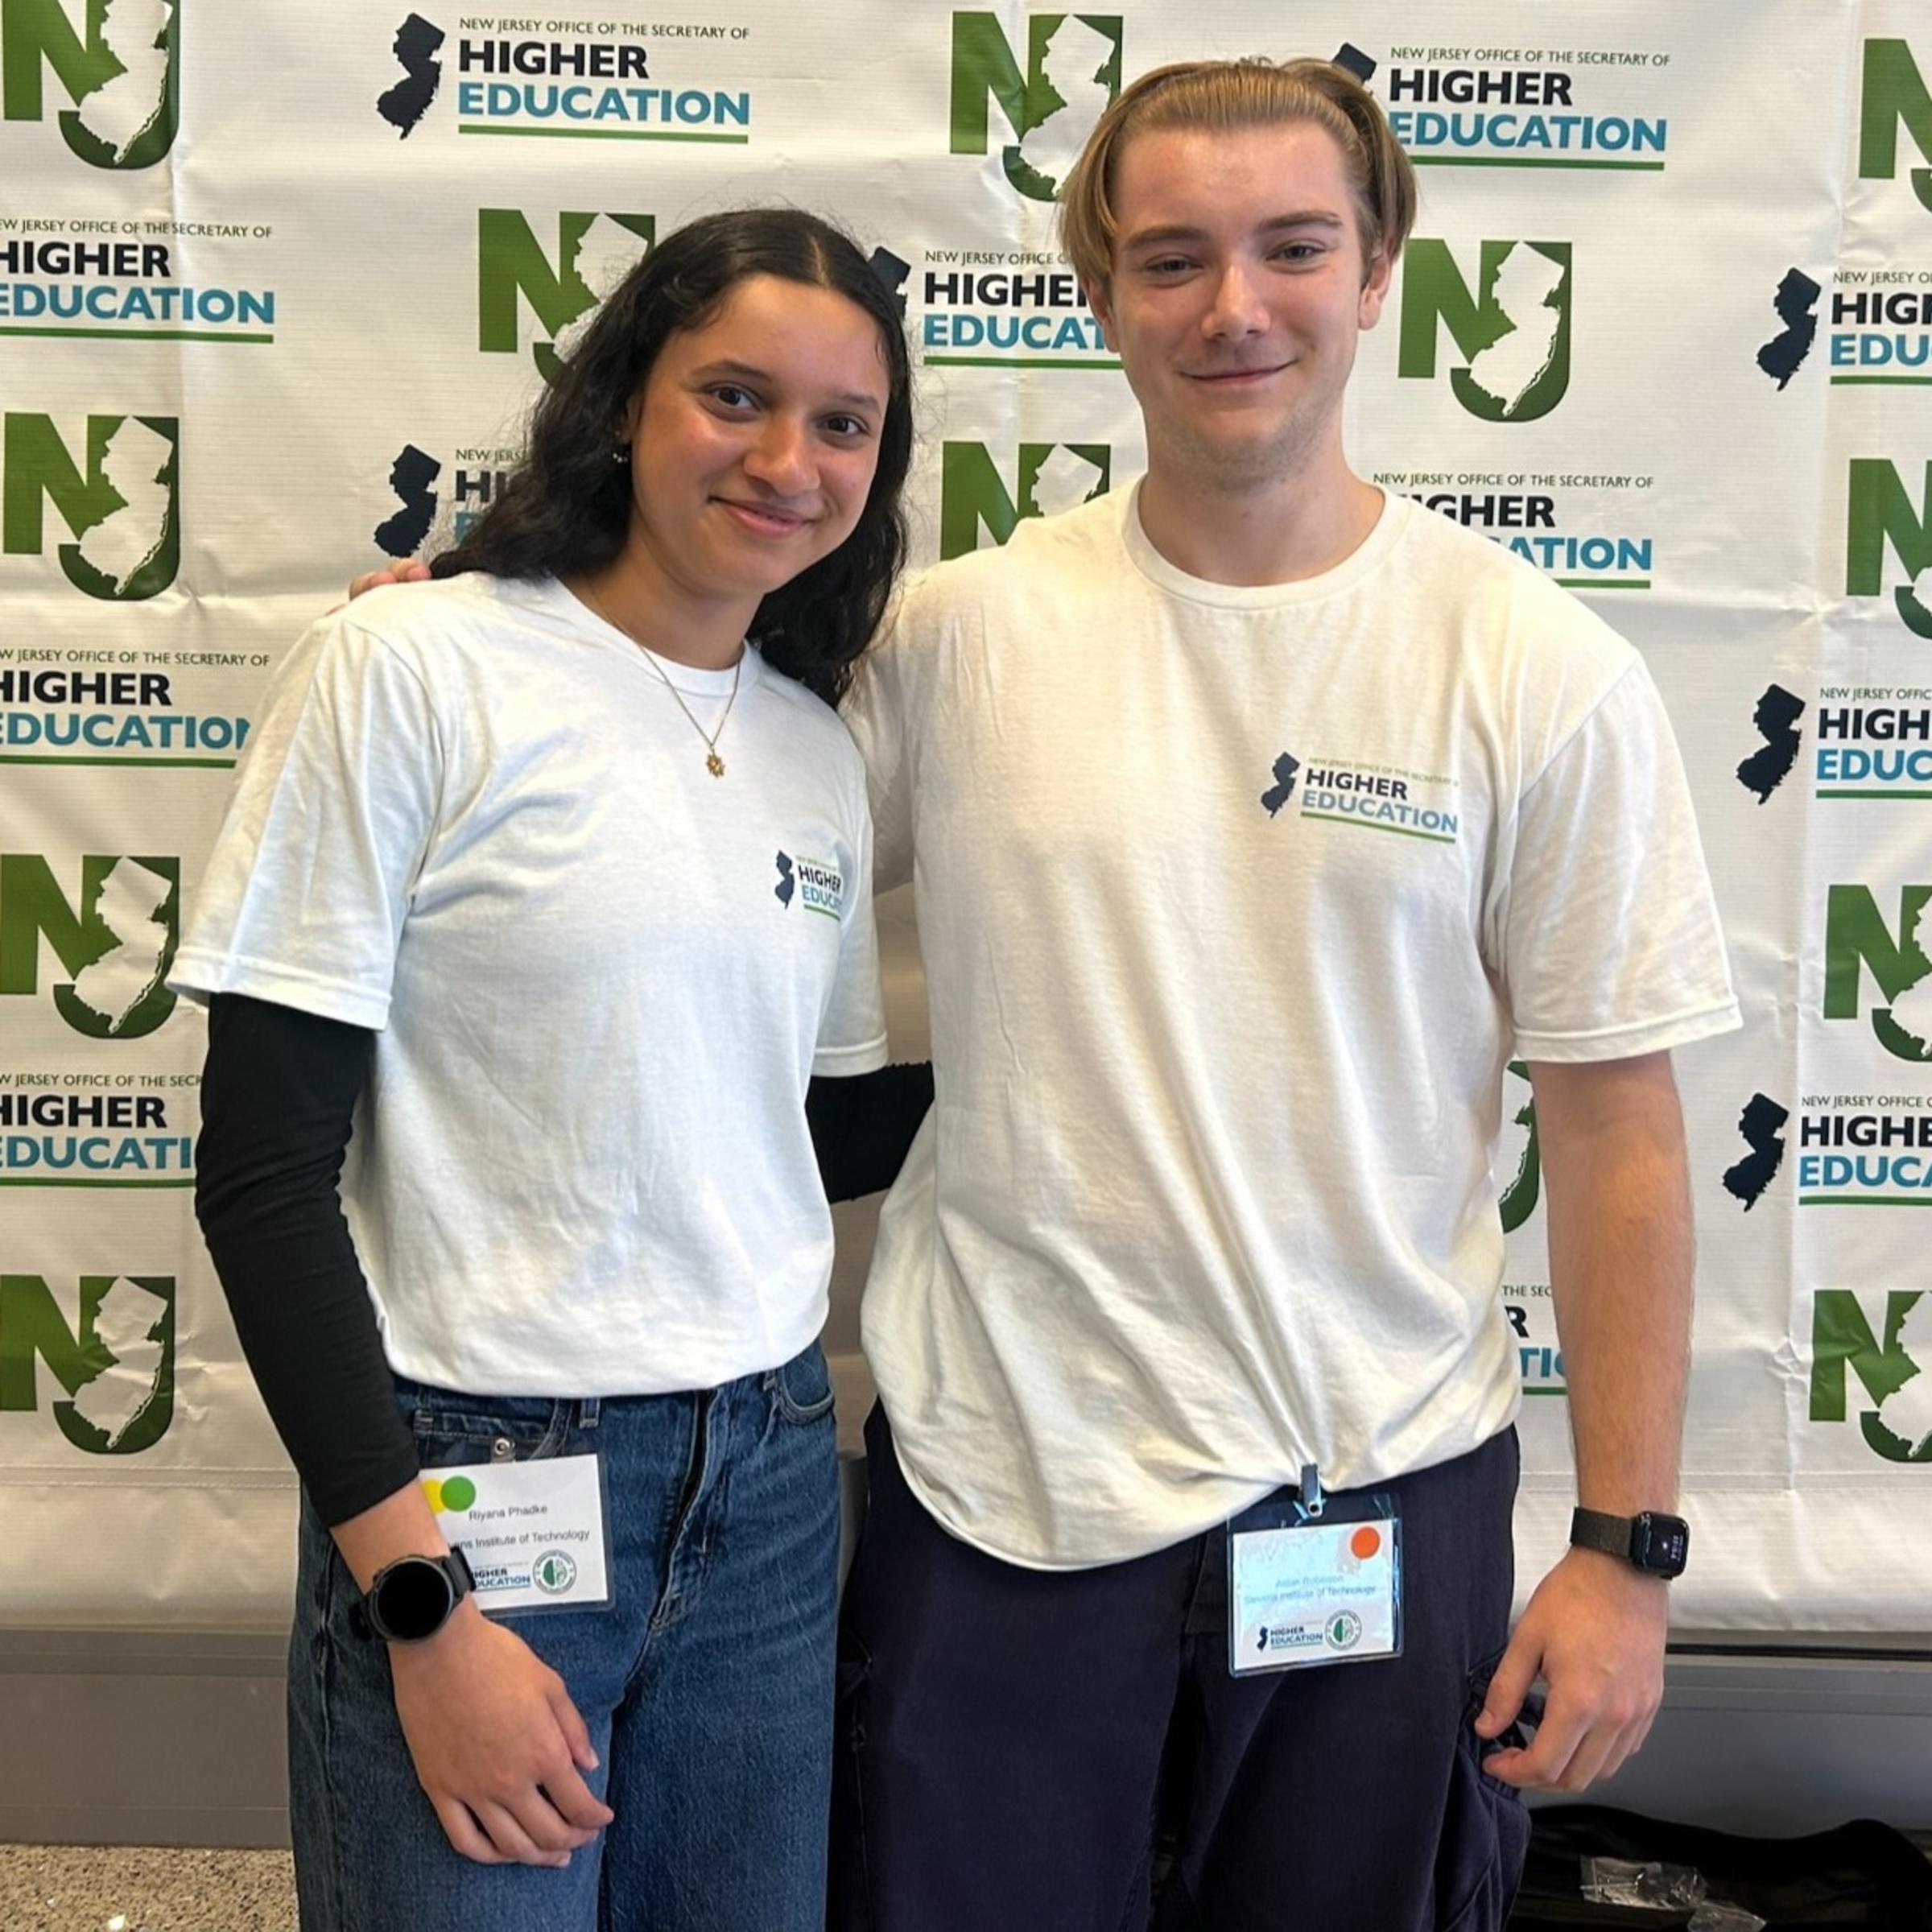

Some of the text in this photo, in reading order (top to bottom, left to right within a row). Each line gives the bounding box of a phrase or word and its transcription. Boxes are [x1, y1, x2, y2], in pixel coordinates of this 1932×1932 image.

[460, 18, 749, 39] NEW JERSEY OFFICE OF THE SECRETARY OF
[459, 39, 650, 79] HIGHER
[1391, 47, 1670, 66] NEW JERSEY OFFICE OF THE SECRETARY OF
[1389, 68, 1572, 106] HIGHER
[459, 80, 749, 126] EDUCATION
[1389, 112, 1666, 151] EDUCATION
[22, 220, 65, 233] JERSEY
[69, 221, 118, 233] OFFICE
[122, 222, 142, 234] OF
[144, 222, 170, 234] THE
[171, 222, 247, 237] SECRETARY
[253, 226, 272, 237] OF
[925, 250, 959, 263] NEW
[961, 252, 1005, 266] JERSEY
[1008, 253, 1054, 266] OFFICE
[1833, 272, 1867, 283] NEW
[1870, 272, 1913, 286] JERSEY
[924, 314, 1105, 349] EDUCAT
[1397, 238, 1572, 423] NJ
[456, 449, 490, 460] NEW
[1373, 473, 1653, 488] NEW JERSEY OFFICE OF THE SECRETARY OF
[2, 411, 180, 601] NJ
[18, 649, 62, 663] JERSEY
[67, 650, 114, 663] OFFICE
[118, 651, 138, 663] OF
[144, 652, 171, 664] THE
[175, 653, 246, 666] SECRETARY
[250, 655, 270, 667] OF
[1820, 687, 1932, 702] NEW JERSEY OFFIC
[0, 712, 250, 750] DUCATIO
[1818, 708, 1930, 740] HIGH
[1305, 768, 1408, 801] HIGHER
[1302, 790, 1458, 833] EDUCATION
[15, 1074, 59, 1088] JERSEY
[64, 1074, 111, 1087] OFFICE
[115, 1075, 134, 1087] OF
[137, 1075, 165, 1087] THE
[1802, 1096, 1831, 1107] NEW
[1833, 1096, 1874, 1108] JERSEY
[1878, 1096, 1923, 1108] OFFICE
[1801, 1116, 1932, 1147] HIGHE
[0, 1135, 192, 1170] DUCATI
[1502, 1285, 1526, 1297] THE
[469, 1505, 547, 1522] Riyana Phadke
[476, 1536, 516, 1548] Institute
[518, 1534, 529, 1544] of
[533, 1529, 590, 1543] Technology
[1270, 1626, 1305, 1637] HIGHER
[1270, 1633, 1323, 1645] EDUCATION
